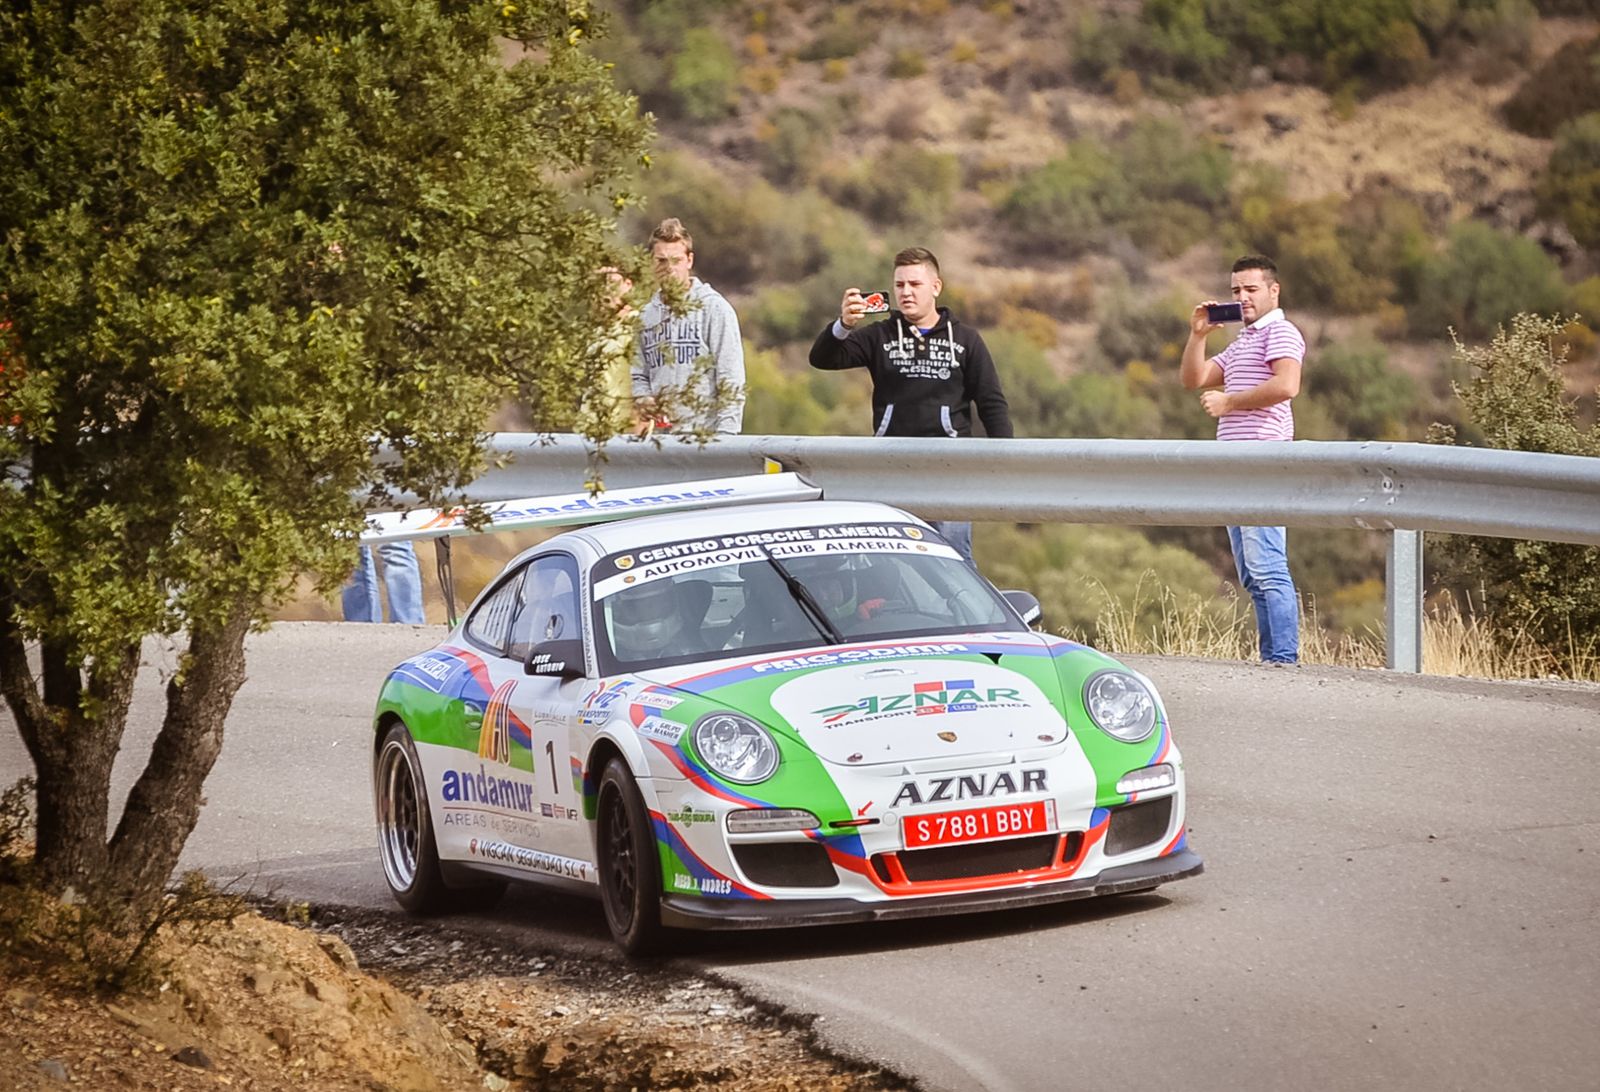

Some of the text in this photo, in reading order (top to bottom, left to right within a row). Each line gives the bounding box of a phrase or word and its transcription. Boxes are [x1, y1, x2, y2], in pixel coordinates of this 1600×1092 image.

[677, 321, 700, 340] LIFE
[493, 488, 735, 518] andamur
[638, 526, 902, 563] CENTRO PORSCHE ALMERIA
[644, 541, 909, 578] AUTOMOVIL CLUB ALMERIA
[751, 643, 969, 673] FRIGODIMA
[811, 688, 1024, 717] AZNAR
[546, 741, 559, 794] 1
[442, 764, 533, 814] andamur
[889, 768, 1049, 809] AZNAR
[444, 813, 487, 828] AREAS
[502, 819, 541, 838] SERVICIO
[917, 808, 1034, 842] S 7881 BBY
[515, 849, 563, 875] SEGURIDAD
